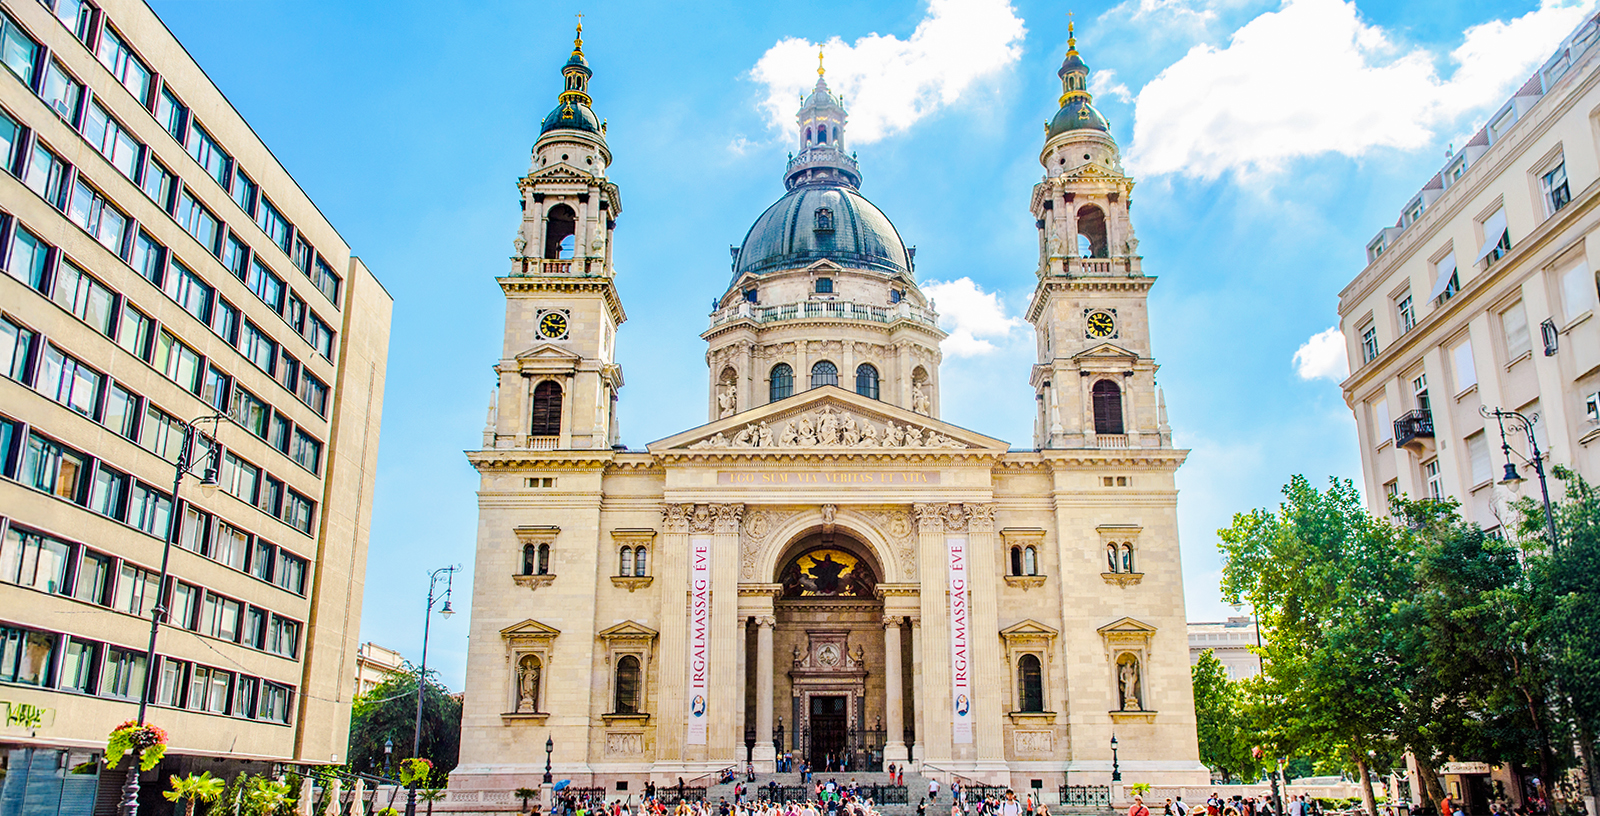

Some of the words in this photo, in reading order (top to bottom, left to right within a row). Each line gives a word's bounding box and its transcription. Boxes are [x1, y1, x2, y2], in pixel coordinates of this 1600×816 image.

[730, 473, 754, 483] EGO
[762, 473, 788, 483] SUM
[798, 473, 818, 483] VIA
[825, 473, 873, 483] VERITAS
[880, 473, 895, 483] ET
[902, 473, 927, 483] VITA
[693, 546, 707, 571] ÉVE
[950, 546, 963, 571] ÉVE
[692, 579, 706, 688] IRGALMASSÁG
[951, 579, 967, 688] IRGALMASSÁG
